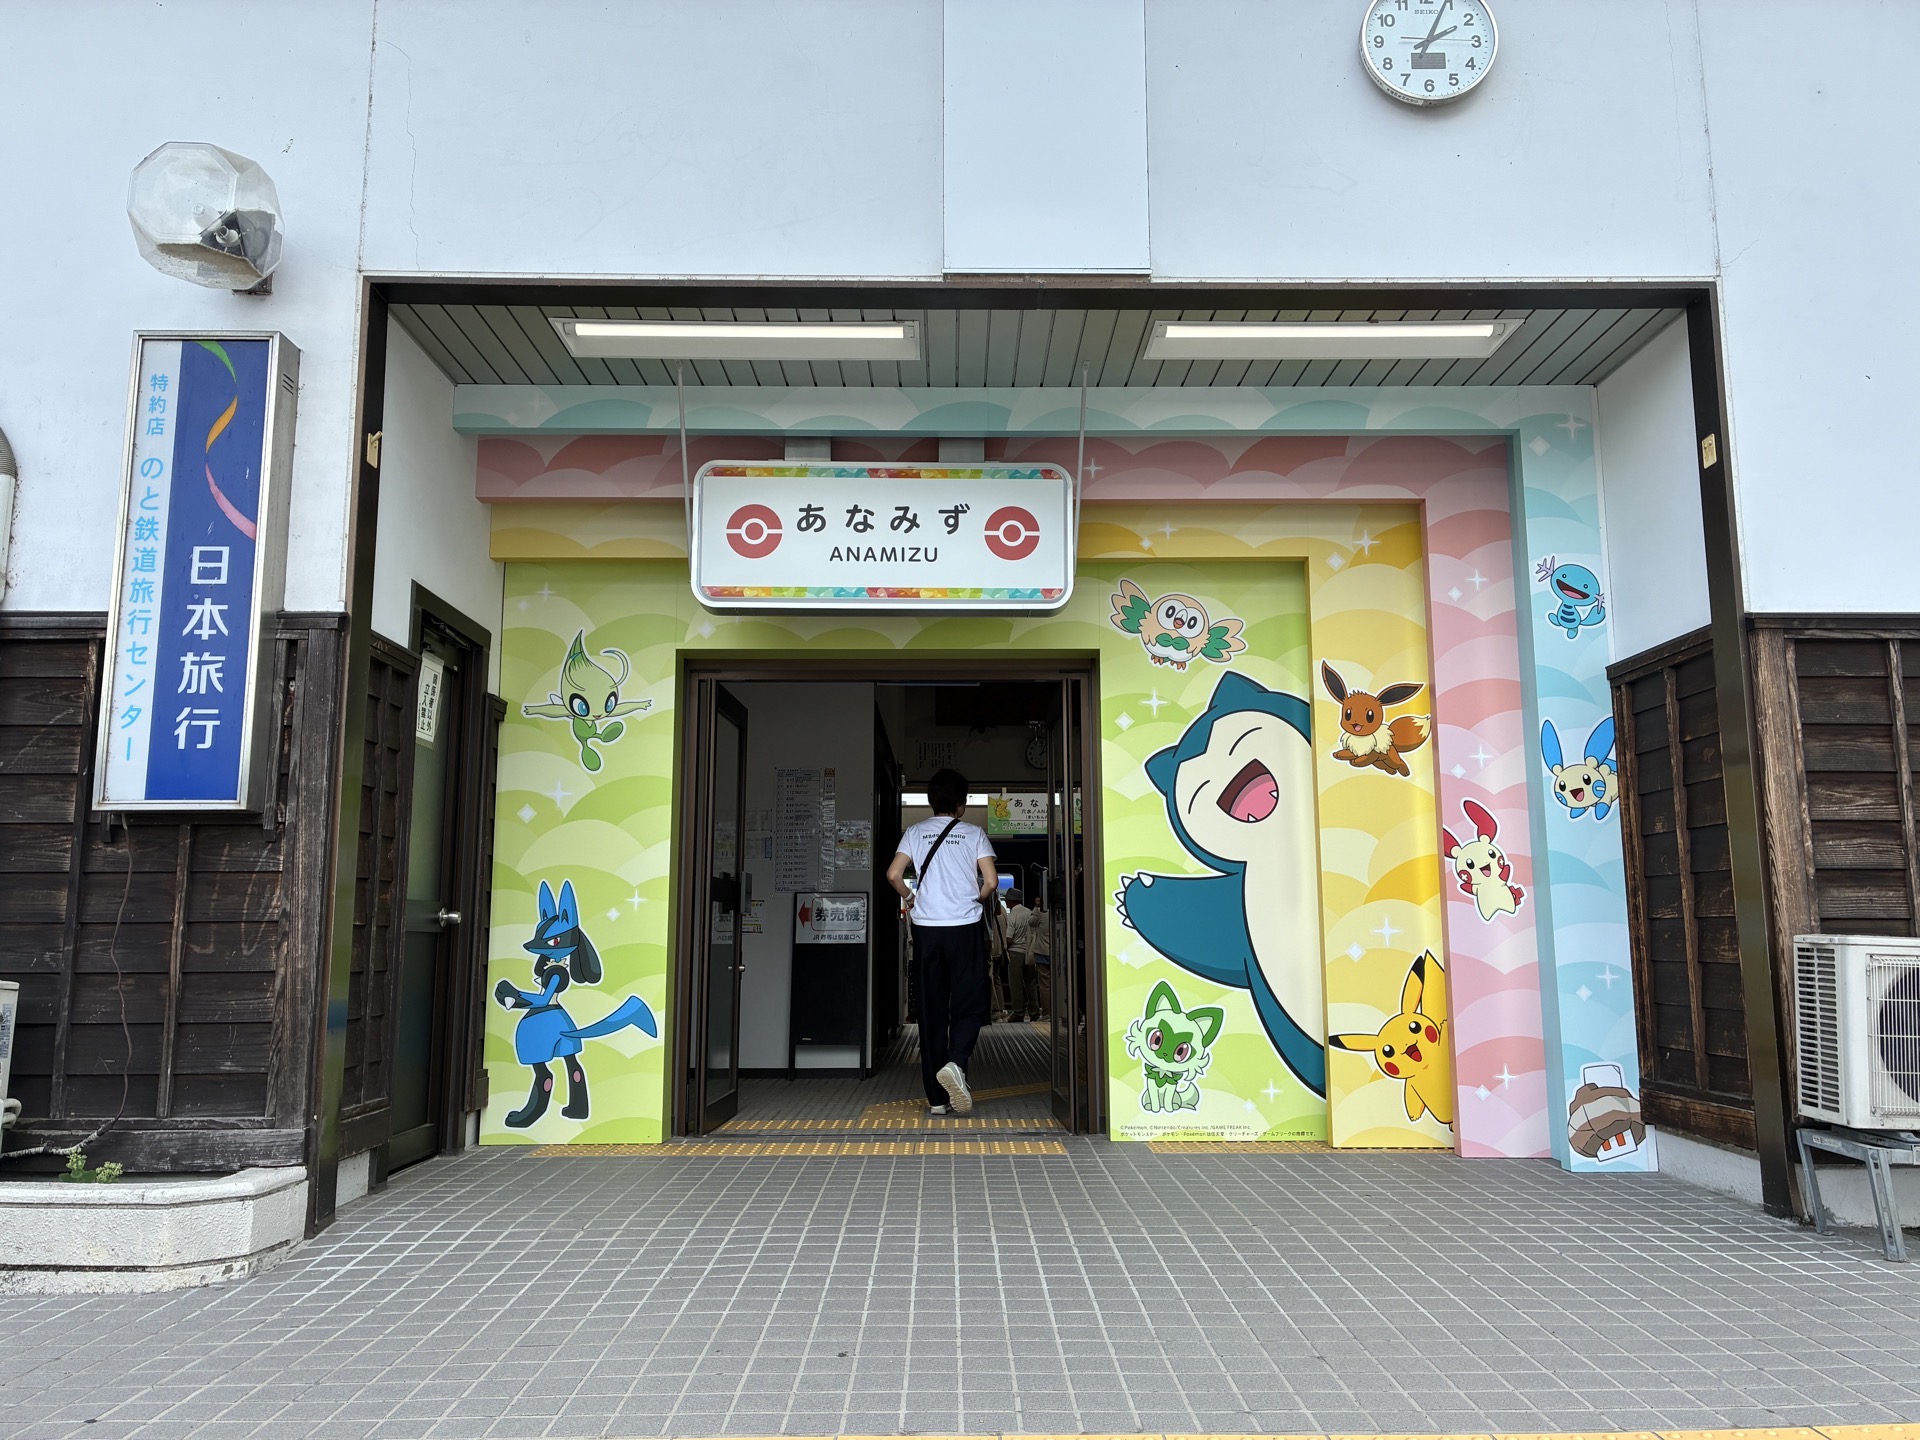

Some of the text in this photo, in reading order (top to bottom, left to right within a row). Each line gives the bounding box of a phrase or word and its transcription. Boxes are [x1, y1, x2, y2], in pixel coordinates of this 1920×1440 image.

[1377, 14, 1395, 27] 10
[1463, 13, 1474, 26] 2
[1373, 35, 1384, 48] 9
[1471, 35, 1481, 48] 3
[1382, 57, 1393, 70] 8
[1465, 57, 1476, 70] 4
[1400, 73, 1411, 86] 7
[1424, 79, 1435, 92] 6
[1449, 73, 1459, 86] 5
[796, 504, 970, 535] あなみず
[829, 546, 938, 562] ANAMIZU
[121, 374, 168, 761] 特約店 のと鉄道旅行センター
[174, 546, 229, 750] 日本旅行
[1014, 799, 1048, 807] あな
[815, 907, 859, 921] 券売機
